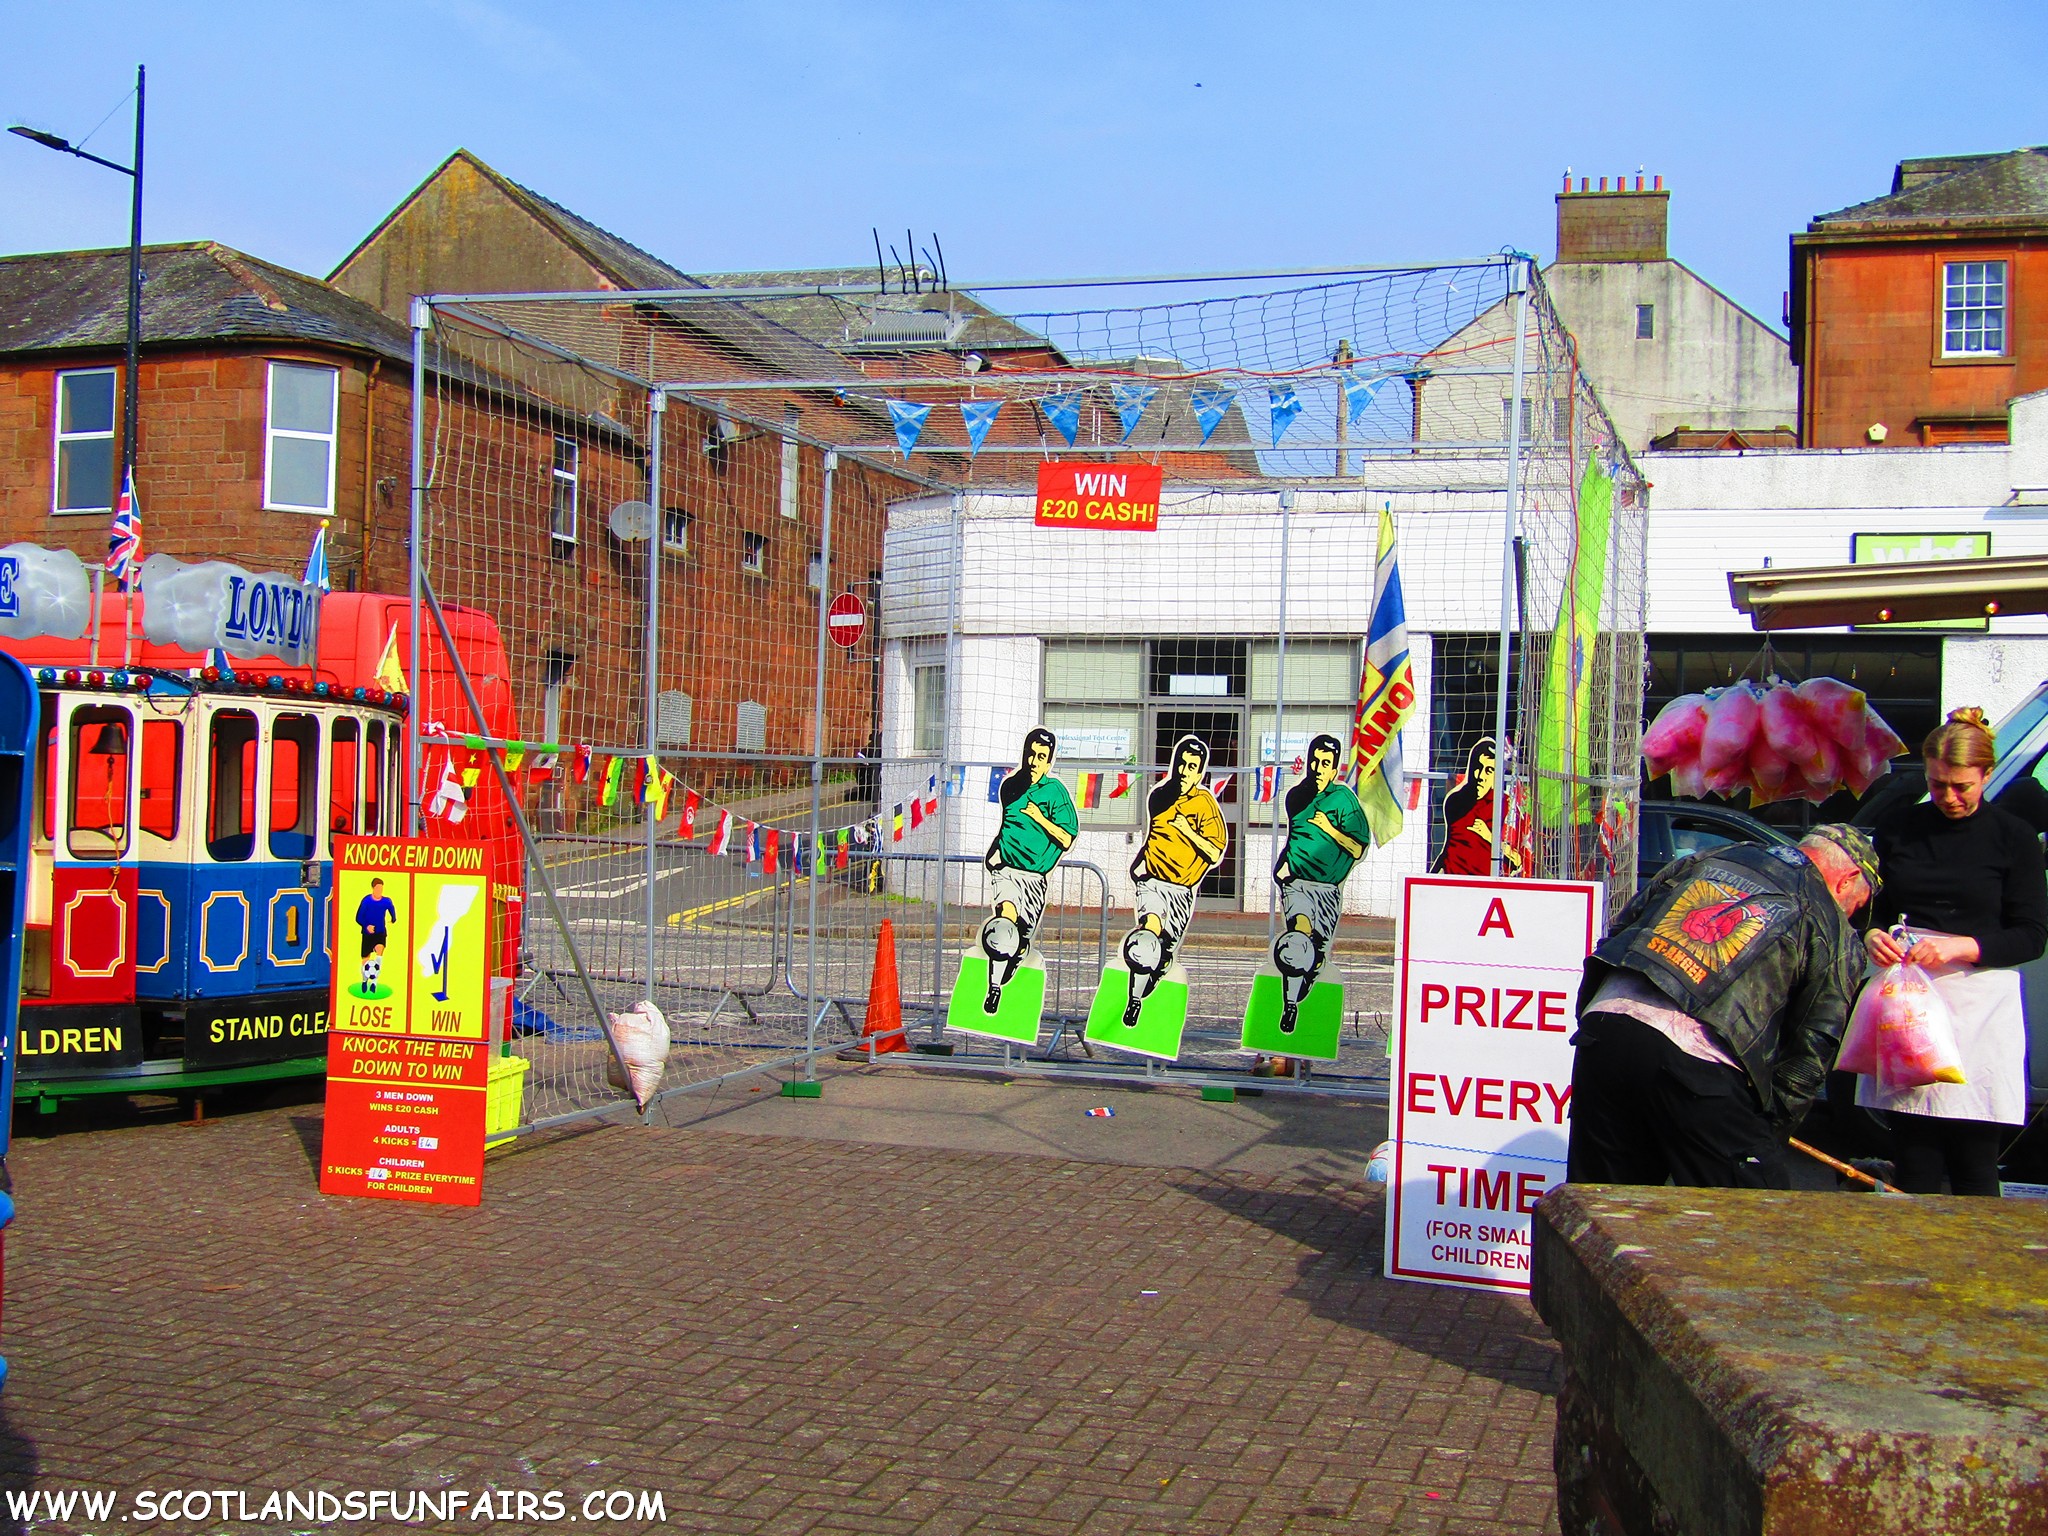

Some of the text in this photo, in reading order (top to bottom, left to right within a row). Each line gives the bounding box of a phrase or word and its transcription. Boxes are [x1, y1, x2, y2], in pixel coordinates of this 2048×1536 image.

[1074, 473, 1127, 497] WIN
[1041, 499, 1155, 522] £20 CASH!
[344, 843, 483, 869] KNOCK EM DOWN
[1477, 897, 1515, 939] A
[350, 1005, 462, 1033] LOSE WIN
[1420, 983, 1568, 1033] PRIZE
[209, 1015, 284, 1043] STAND
[342, 1037, 474, 1060] KNOCK THE MEN
[352, 1059, 463, 1080] DOWN TO WIN
[375, 1090, 434, 1102] 3 MEN DOWN
[1407, 1072, 1573, 1125] EVERY
[369, 1103, 439, 1115] WINS £20 CASH
[373, 1136, 379, 1144] 4
[381, 1137, 410, 1146] KICKS
[384, 1125, 421, 1135] ADULTS
[327, 1165, 334, 1174] 5
[335, 1167, 363, 1176] KICKS
[395, 1171, 422, 1181] PRIZE
[423, 1173, 476, 1185] EVERYTIME
[378, 1158, 425, 1169] CHILDREN
[367, 1182, 433, 1194] FOR CHILDREN
[1427, 1164, 1547, 1215] TIME
[1426, 1220, 1532, 1247] (FOR SMAL
[1431, 1245, 1530, 1271] CHILDREN
